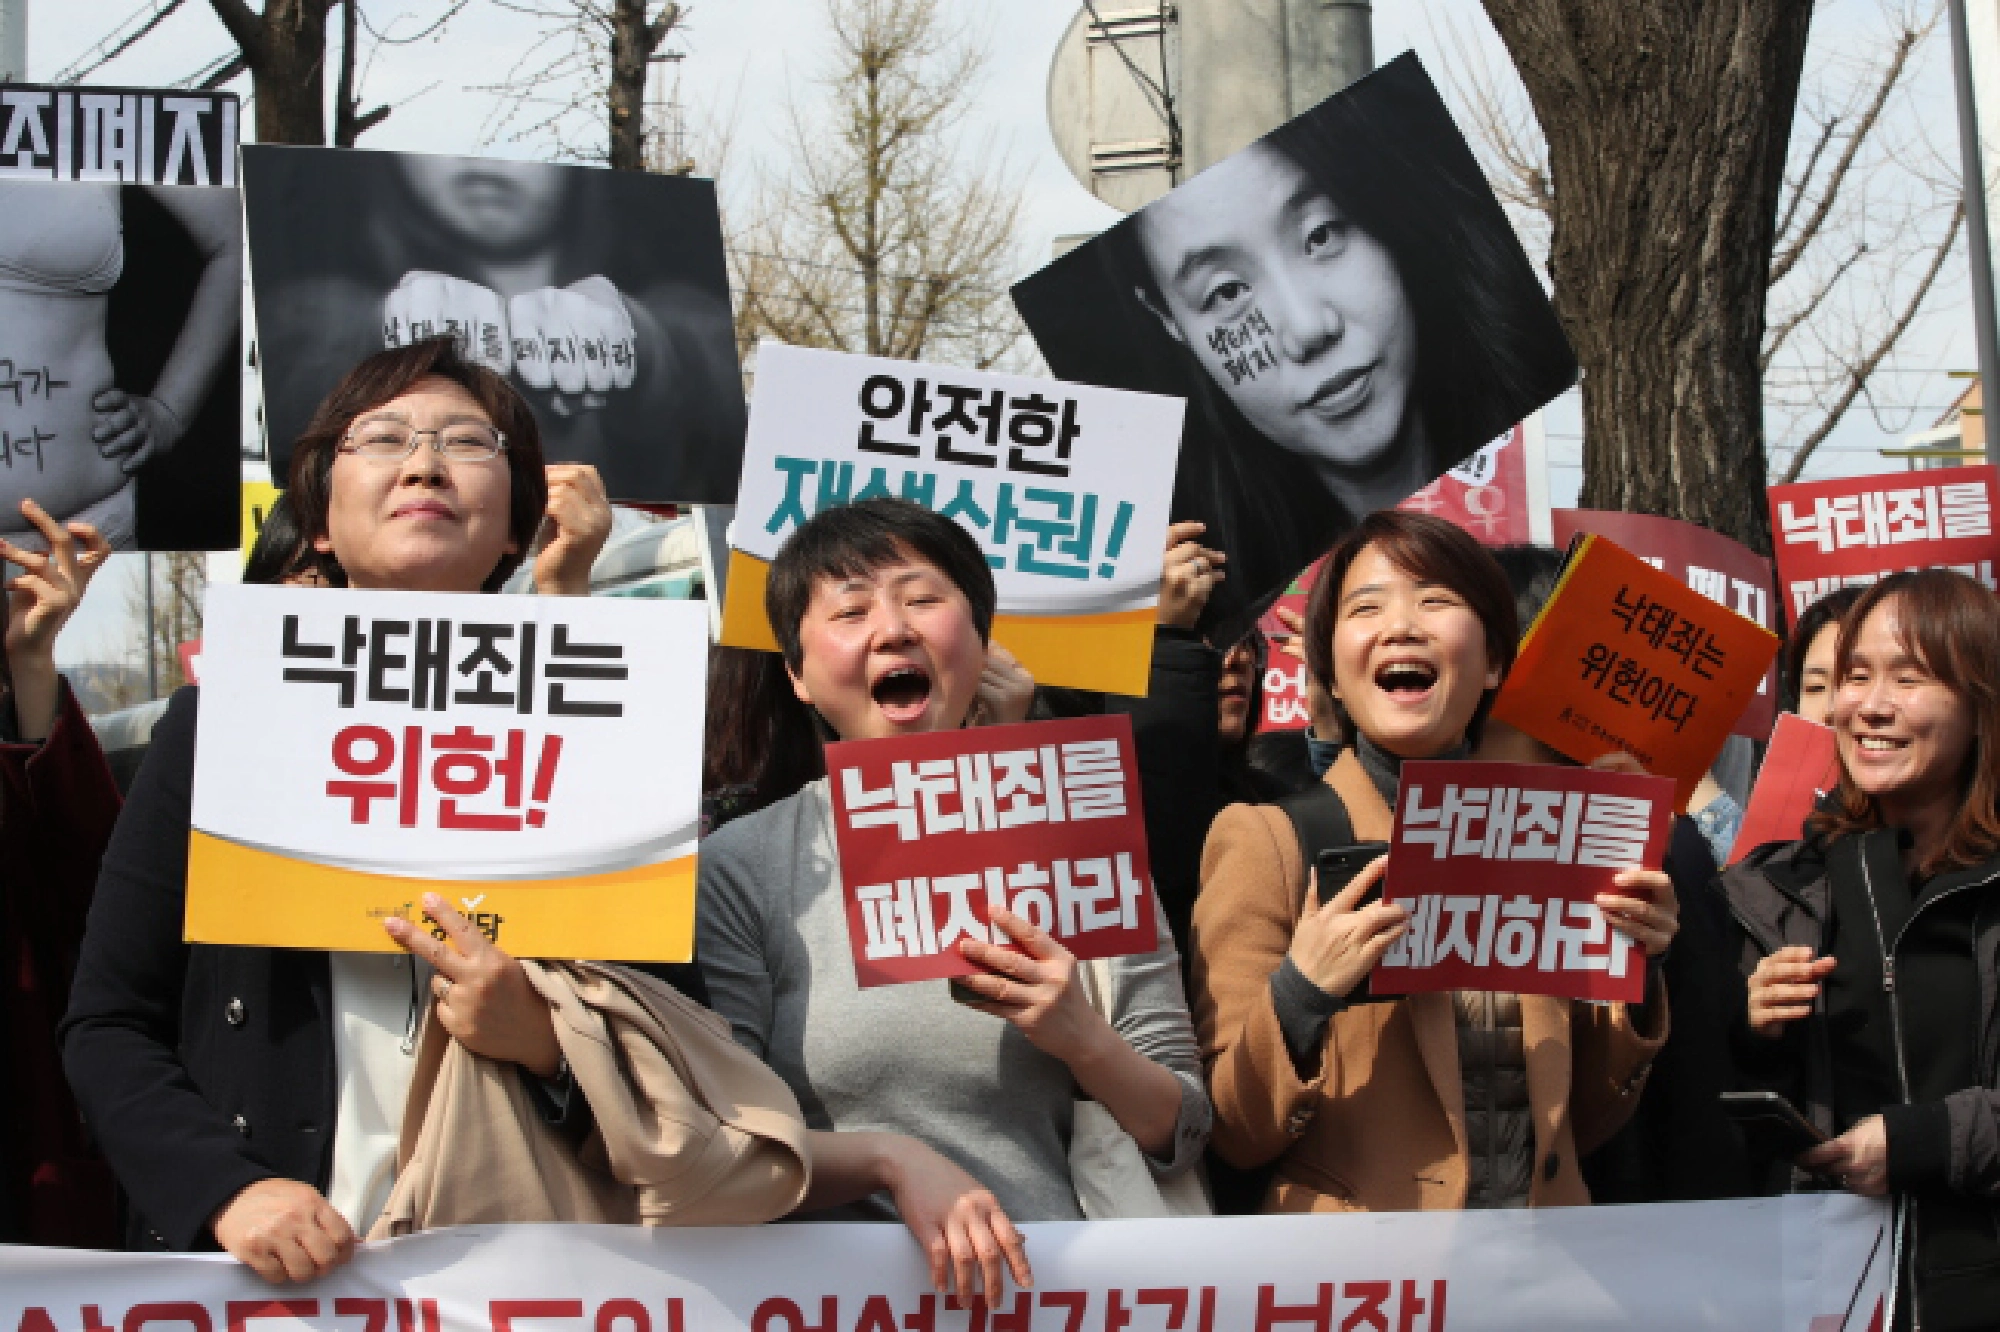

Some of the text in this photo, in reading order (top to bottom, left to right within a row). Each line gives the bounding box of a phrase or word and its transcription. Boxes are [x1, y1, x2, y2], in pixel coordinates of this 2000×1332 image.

[857, 374, 1081, 477] 안전한
[1777, 480, 1991, 554] 낙태죄를
[281, 613, 629, 719] 낙태죄는
[1611, 583, 1726, 681] 낙태죄는
[1577, 641, 1699, 734] 위헌이다
[325, 723, 565, 833] 위헌!
[840, 737, 1128, 841] 낙태죄를
[1401, 784, 1653, 870] 낙태죄를
[855, 851, 1143, 961] 폐지하라
[1381, 894, 1634, 980] 폐지하라
